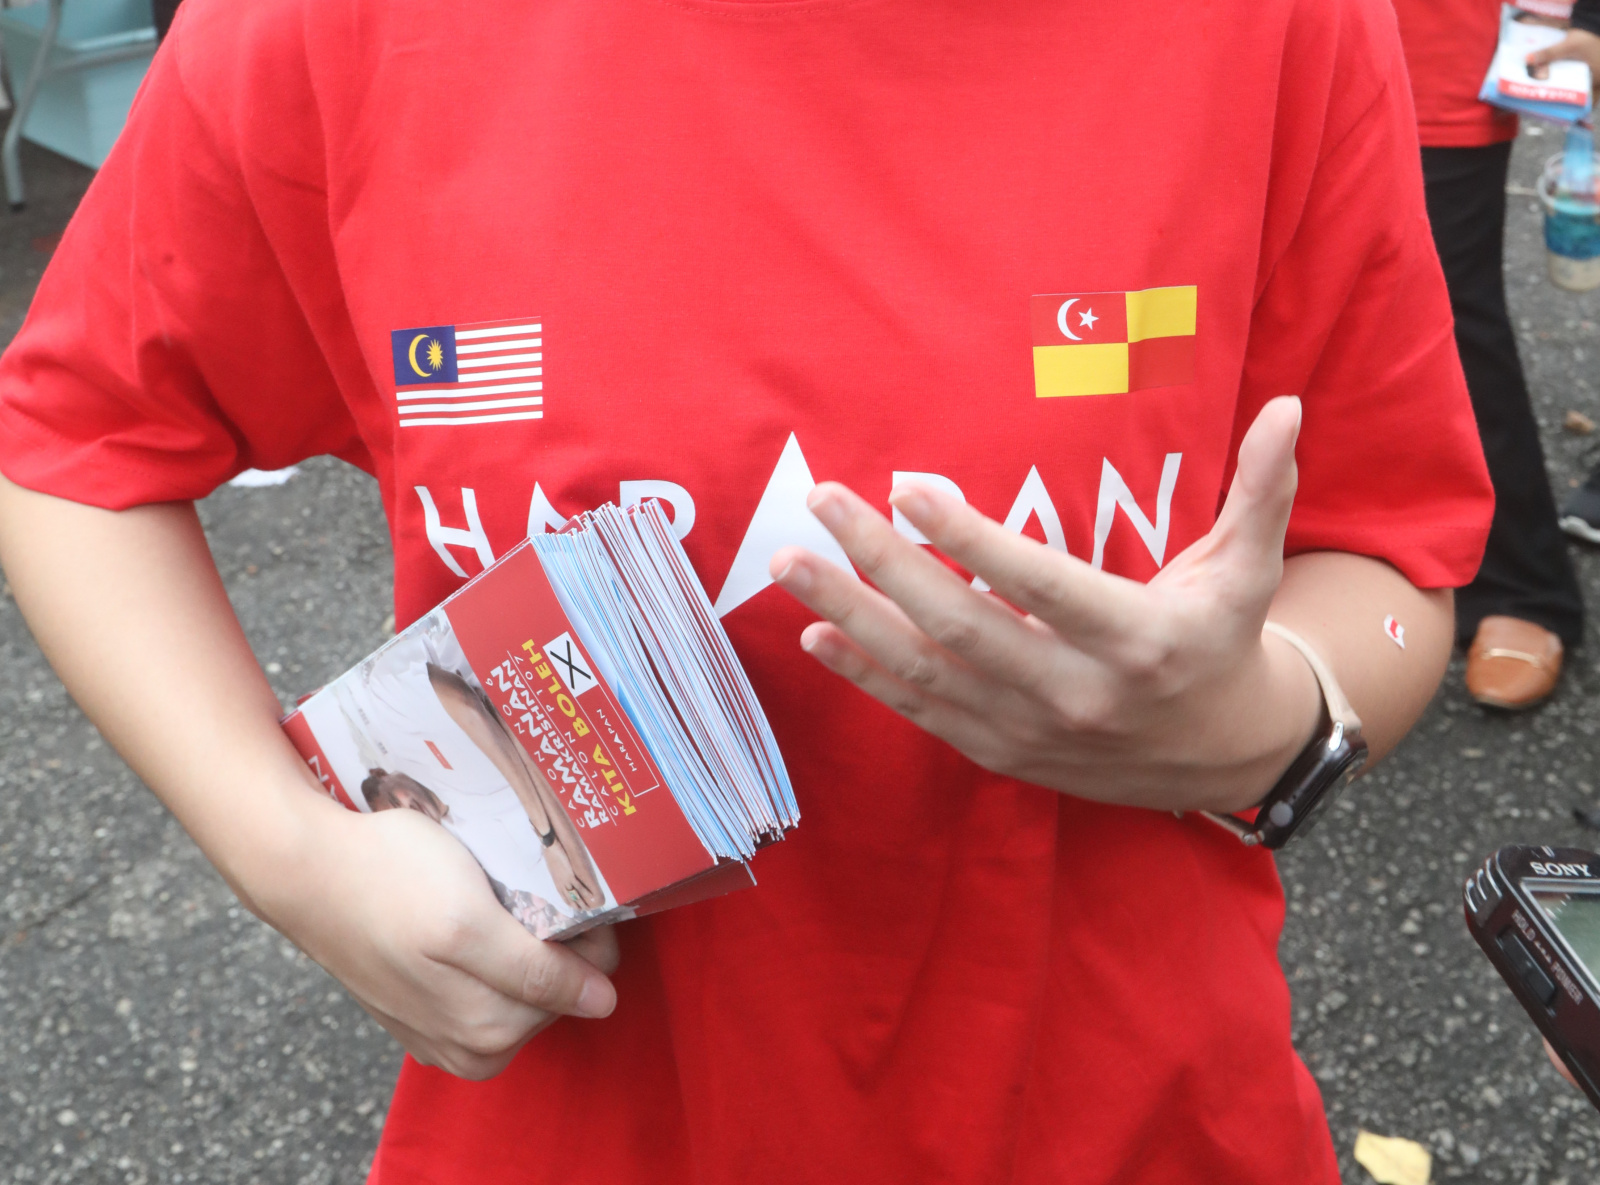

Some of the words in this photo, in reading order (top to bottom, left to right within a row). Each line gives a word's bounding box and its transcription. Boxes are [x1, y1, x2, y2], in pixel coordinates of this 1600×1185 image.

[484, 676, 494, 687] 6
[501, 703, 526, 735] NO
[513, 655, 555, 713] P107
[521, 638, 591, 737] BOLEH
[489, 661, 603, 829] RAMANAN
[501, 659, 610, 824] RAMAKRISHNAN
[563, 730, 619, 816] CALON
[596, 707, 638, 772] HARAPAN
[532, 749, 586, 828] CALON
[591, 742, 637, 816] KITA
[1530, 861, 1592, 877] SONY
[1511, 909, 1536, 942] HOLD
[1551, 960, 1584, 1005] POWER
